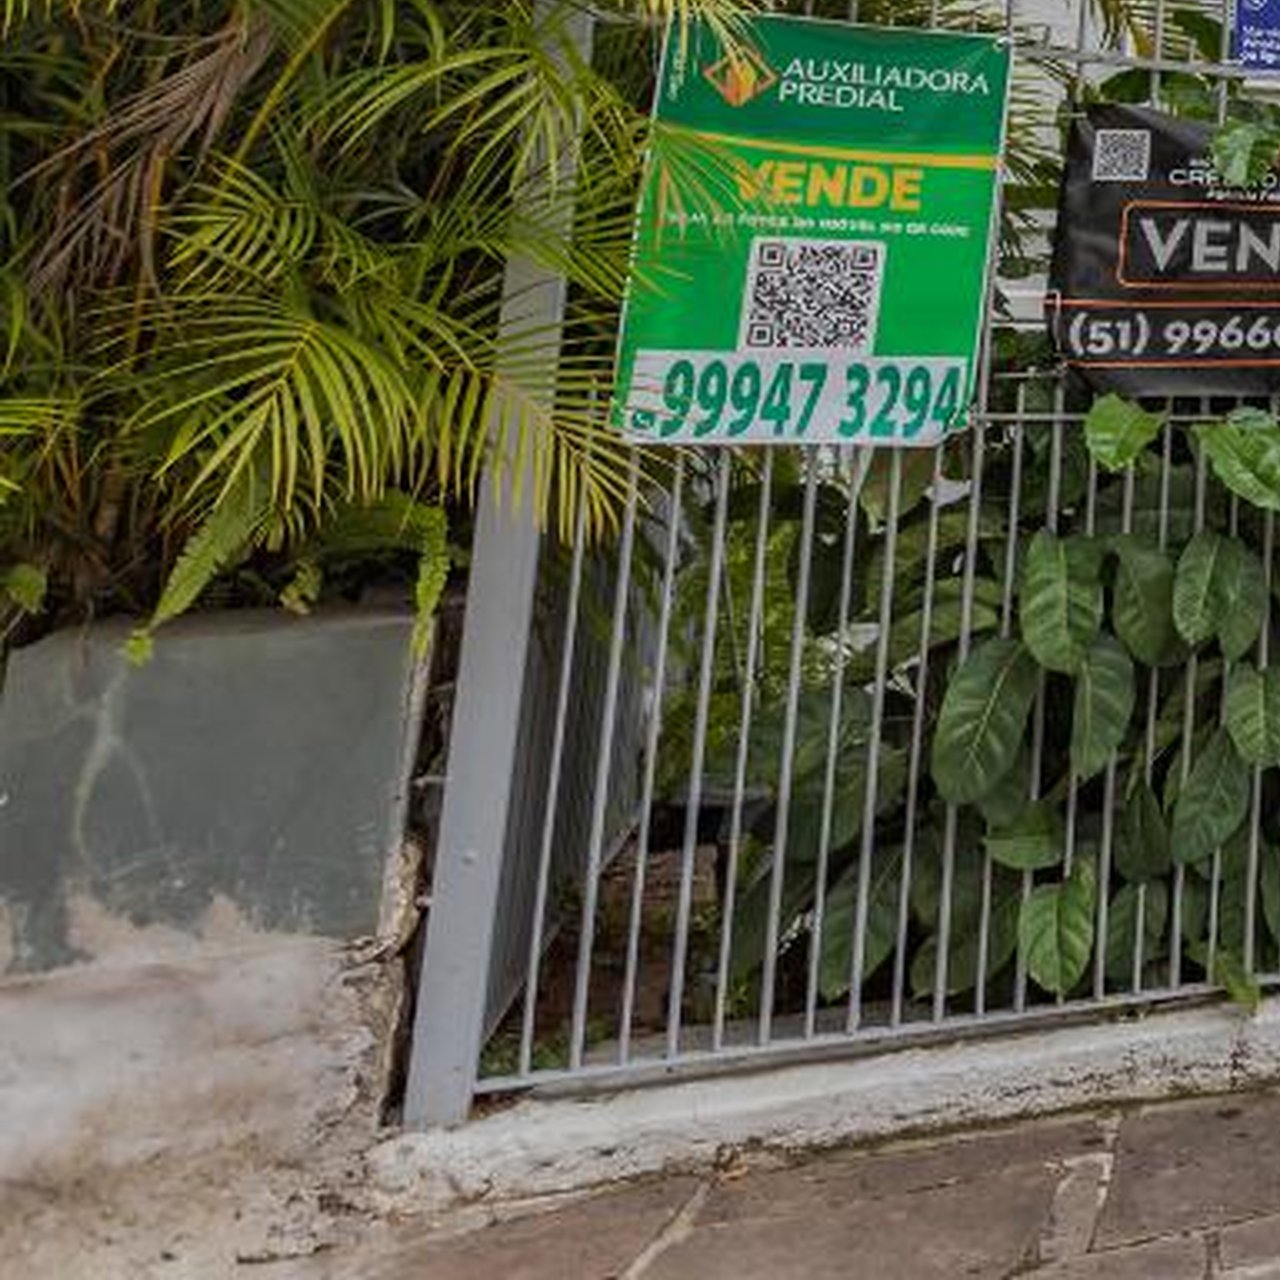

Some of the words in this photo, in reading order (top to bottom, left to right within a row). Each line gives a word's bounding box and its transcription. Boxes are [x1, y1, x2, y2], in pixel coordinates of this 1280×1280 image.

[778, 80, 905, 112] PREDIAL
[781, 58, 991, 95] AUXILIADORA
[735, 157, 924, 212] VENDE
[1068, 311, 1150, 356] (51)
[659, 359, 828, 438] 99947
[837, 363, 963, 438] 3294
